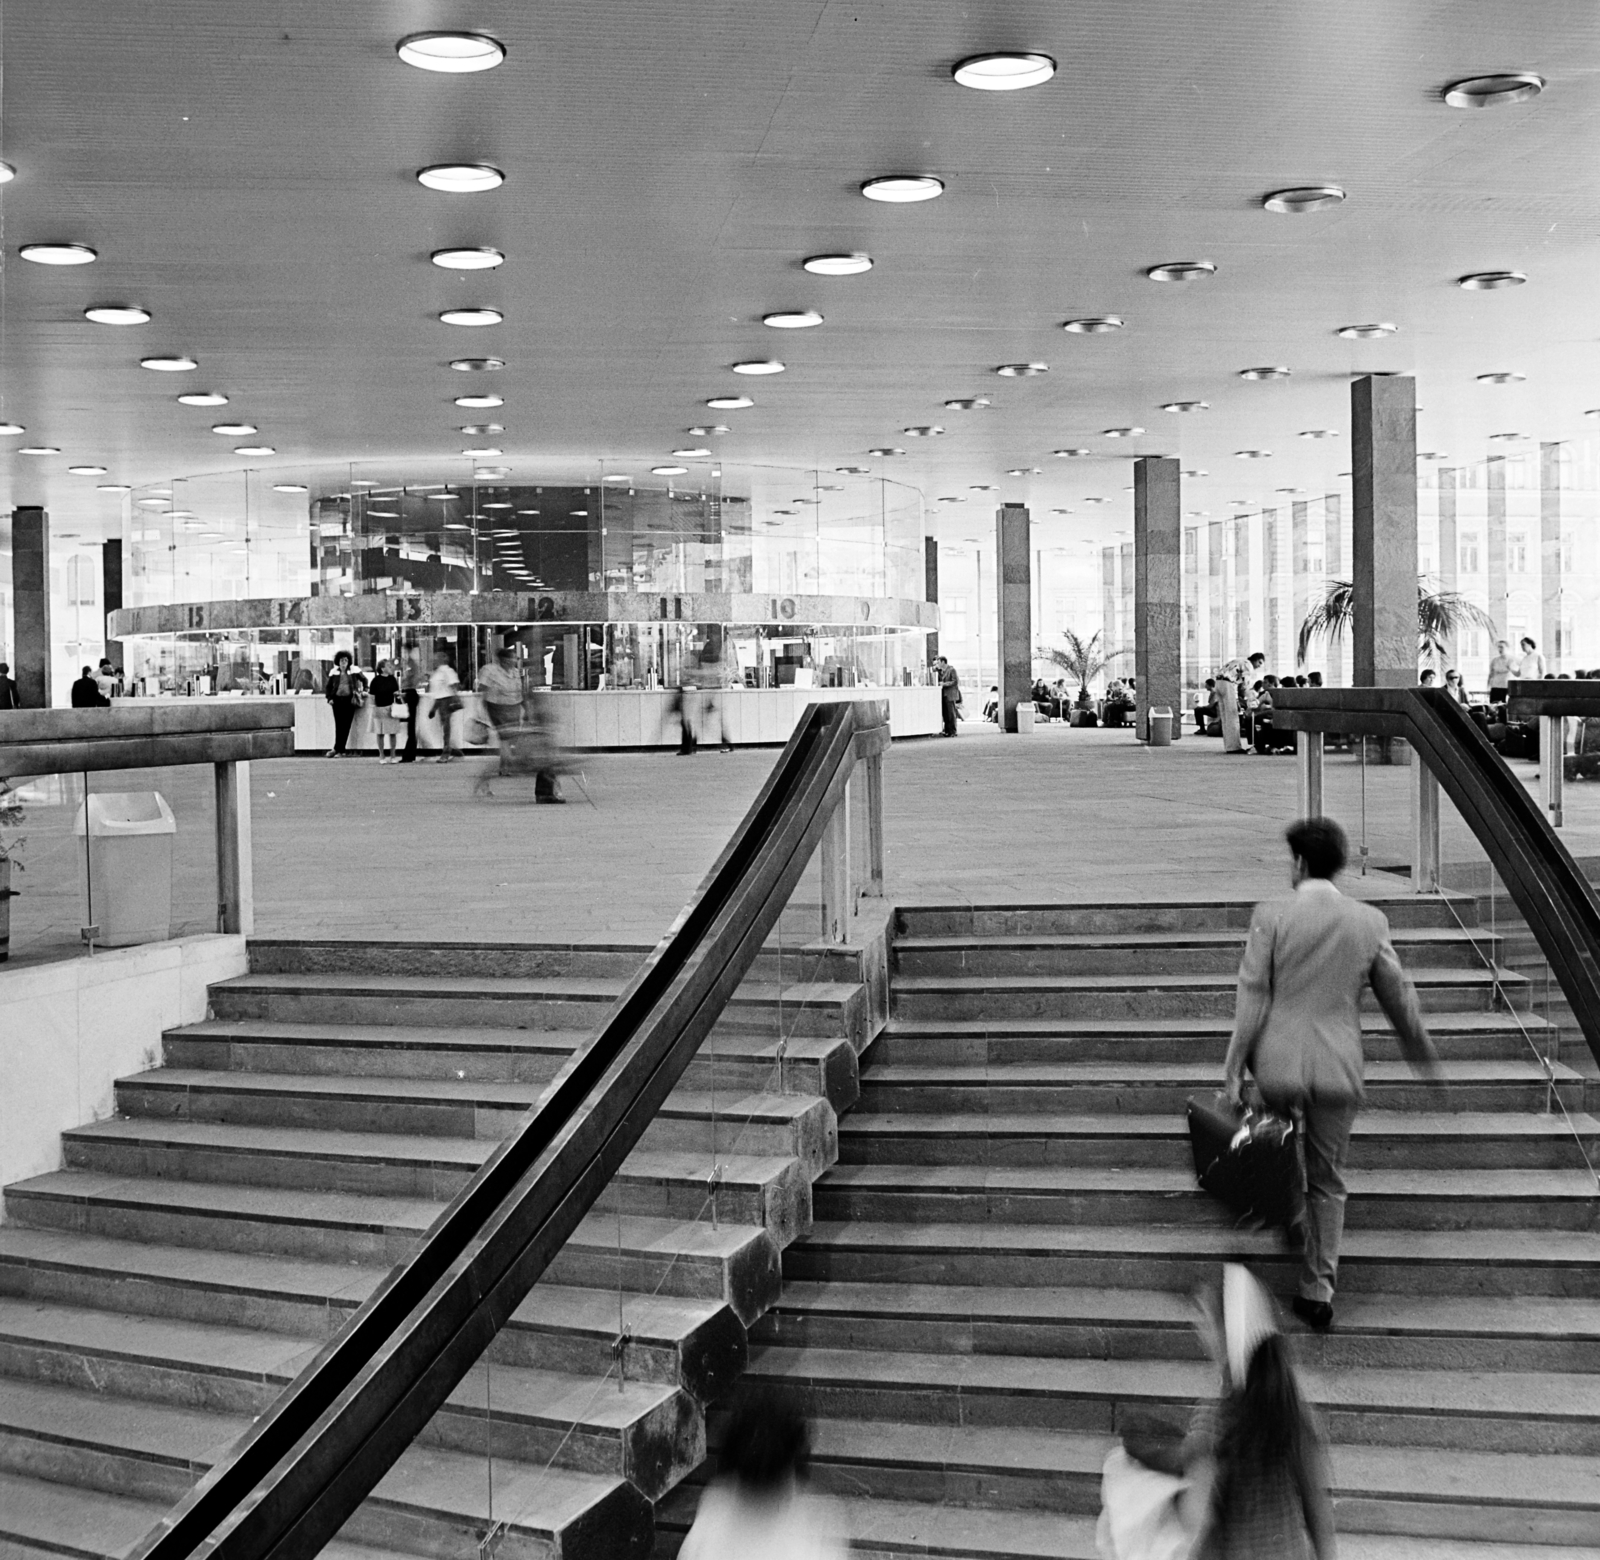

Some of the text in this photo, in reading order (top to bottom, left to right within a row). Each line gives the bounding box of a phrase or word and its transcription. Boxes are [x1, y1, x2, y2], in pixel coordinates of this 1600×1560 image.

[188, 606, 204, 628] 15
[396, 599, 421, 621] 13
[528, 597, 555, 619] 12
[660, 598, 681, 619] 11
[771, 598, 796, 620] 10
